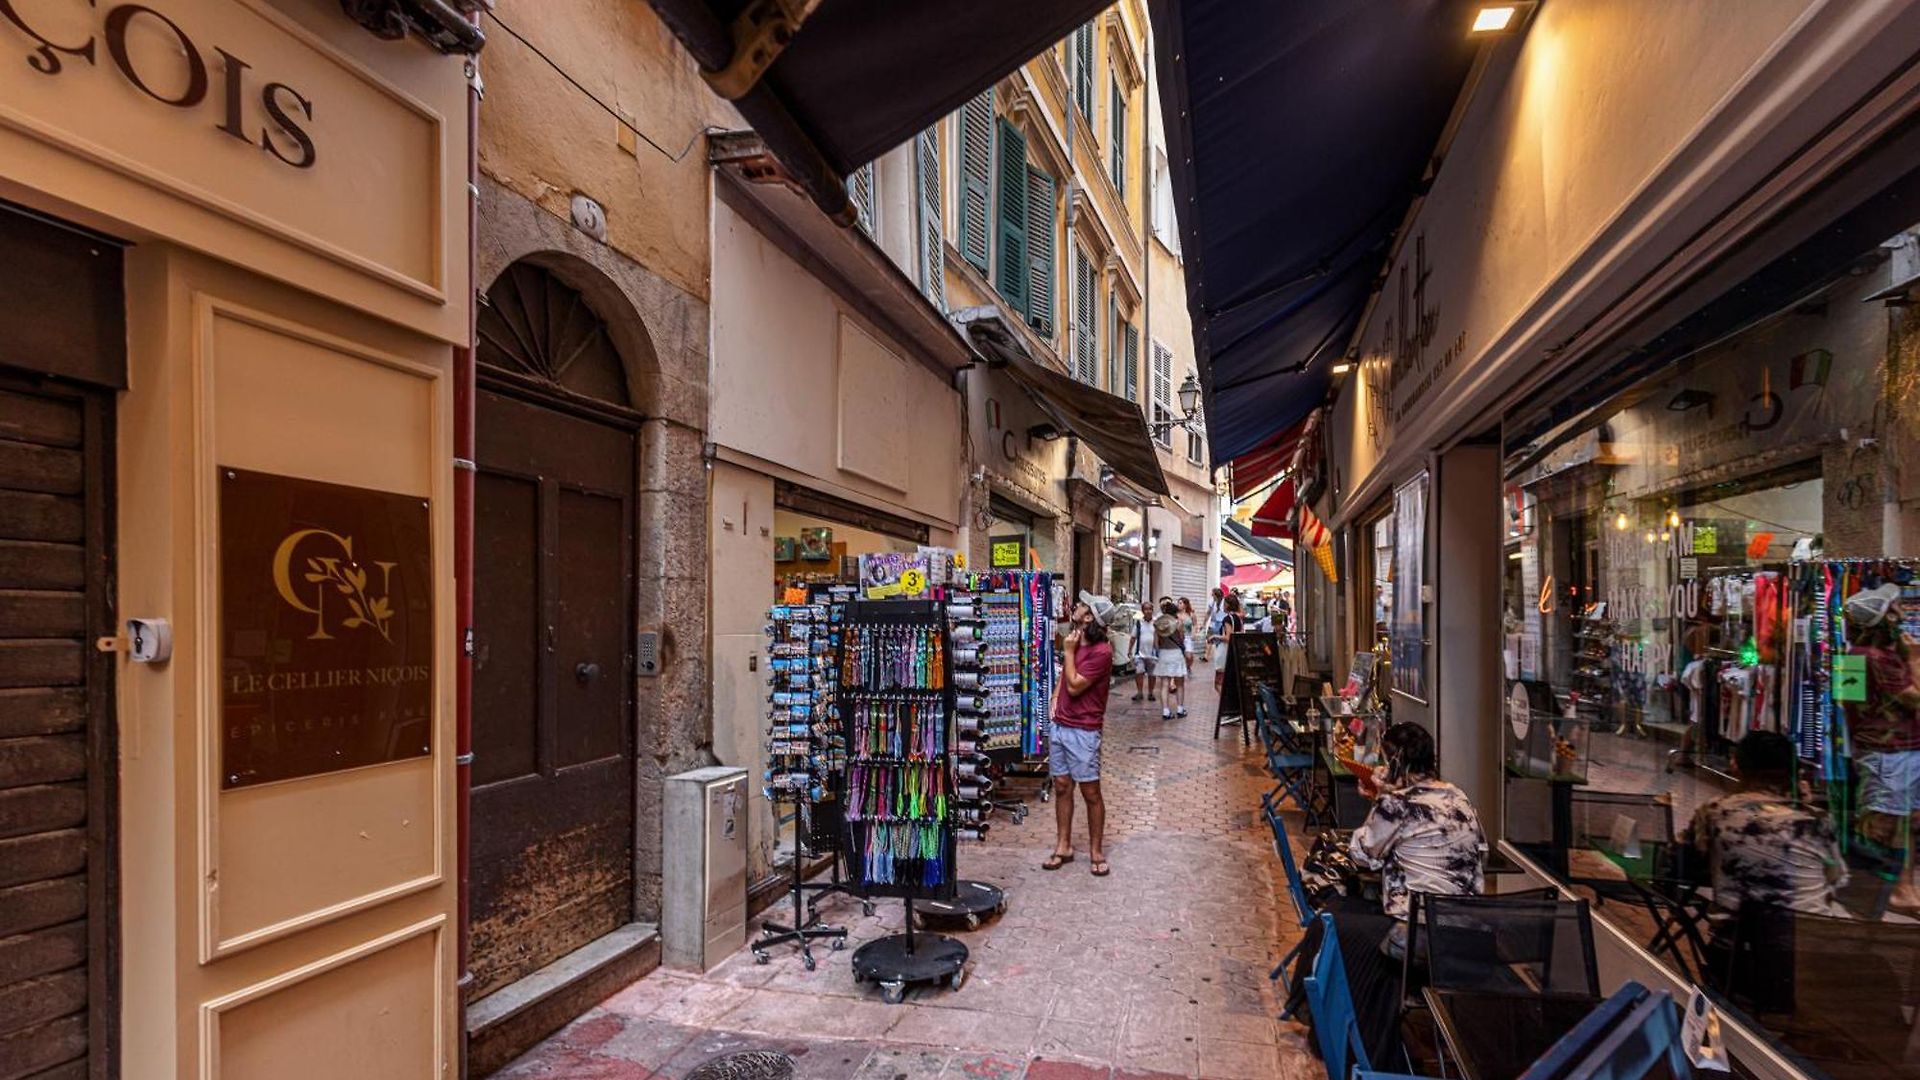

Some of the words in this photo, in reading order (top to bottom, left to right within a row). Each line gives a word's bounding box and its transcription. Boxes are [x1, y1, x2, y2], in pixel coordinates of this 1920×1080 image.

[1664, 581, 1699, 619] YOU
[1621, 640, 1673, 677] HAPPY
[232, 675, 264, 694] LE
[267, 670, 362, 692] CELLIER
[365, 665, 429, 687] NIÇOIS
